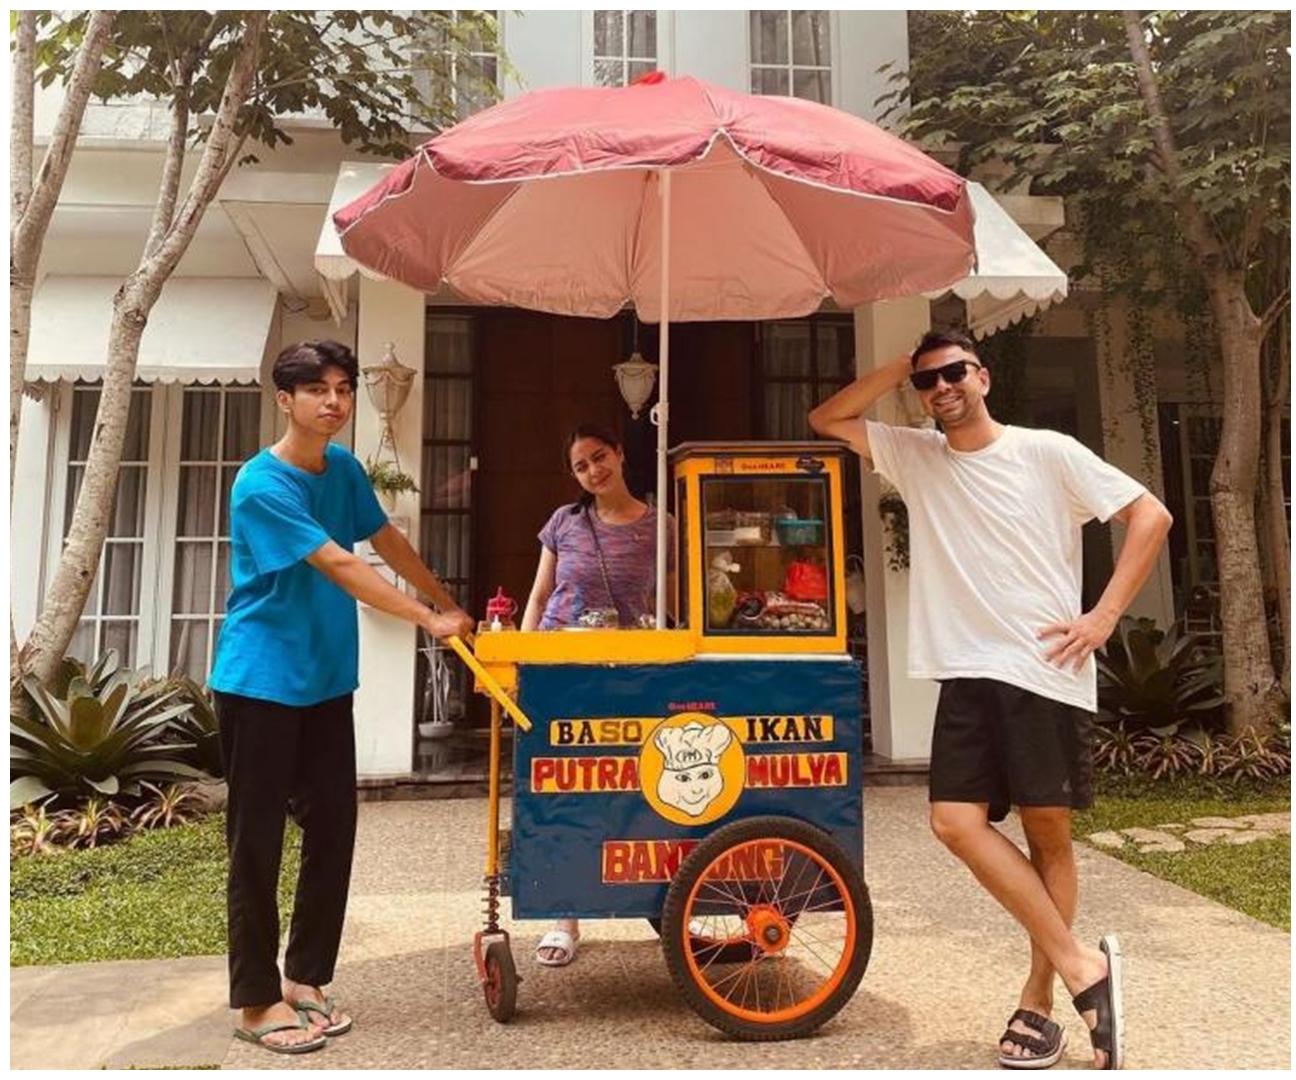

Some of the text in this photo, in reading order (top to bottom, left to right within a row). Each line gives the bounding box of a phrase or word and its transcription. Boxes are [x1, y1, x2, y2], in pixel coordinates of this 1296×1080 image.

[557, 717, 823, 744] BASO IKAN
[534, 754, 842, 791] PUTRA MULYA
[605, 842, 783, 879] BANNG
